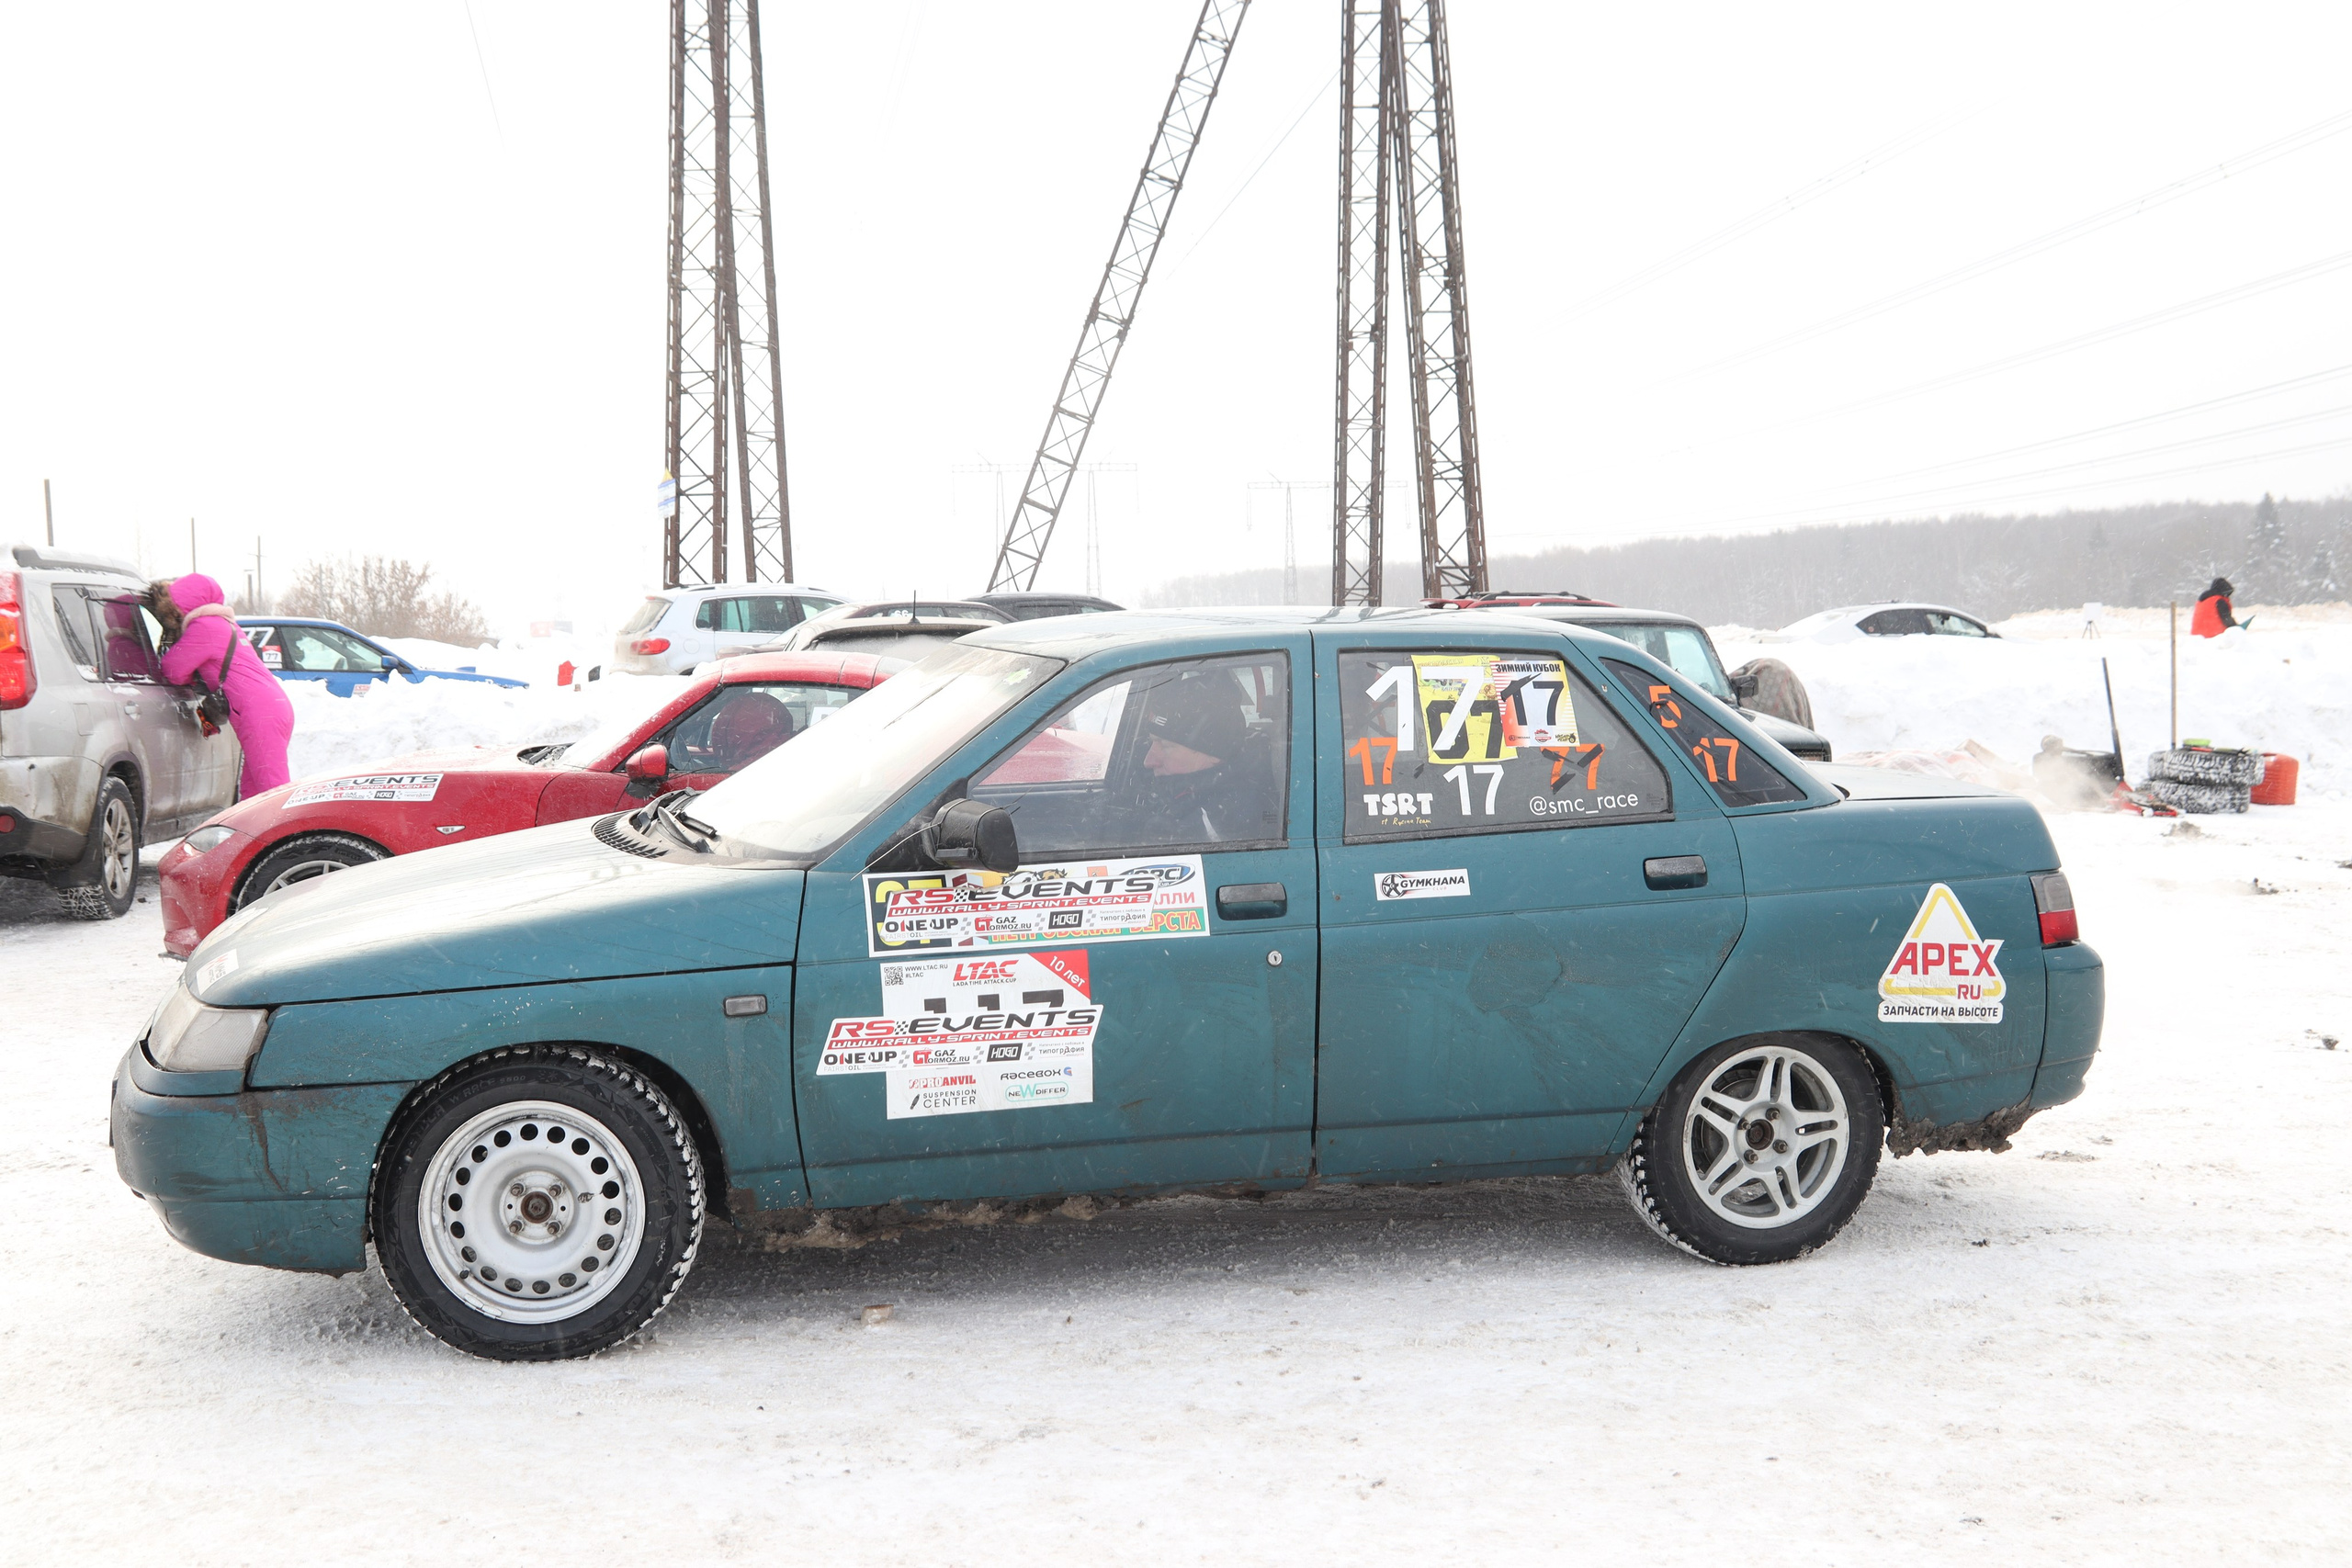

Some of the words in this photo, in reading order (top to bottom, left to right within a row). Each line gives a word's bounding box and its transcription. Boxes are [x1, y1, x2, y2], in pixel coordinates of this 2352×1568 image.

[1496, 662, 1532, 672] ЗИМНИЙ
[1533, 663, 1561, 672] КУБОК
[1365, 665, 1485, 751] 17
[1500, 680, 1565, 726] 17
[1349, 737, 1398, 786] 17
[1692, 738, 1739, 783] 17
[335, 774, 439, 787] EVENTS
[1443, 764, 1505, 816] 17
[1363, 793, 1433, 816] TSRT
[1529, 794, 1639, 816] @smc_race
[891, 888, 956, 906] RS
[967, 876, 1156, 901] EVENTS
[1400, 875, 1465, 888] GYMKHANA
[1154, 892, 1195, 906] ЛЛИ
[905, 964, 948, 972] WWW.LTAC.RU
[1890, 942, 1996, 976] APEX
[953, 960, 1019, 981] LTAC
[1049, 955, 1065, 972] 10
[1063, 968, 1086, 987] лет
[1957, 984, 1981, 999] RU
[1883, 1005, 1939, 1016] ЗАПЧАСТИ
[1941, 1007, 1955, 1017] НА
[1958, 1008, 1998, 1017] ВЫСОТЕ
[831, 1020, 895, 1038] RS
[909, 1010, 1097, 1033] EVENTS
[920, 1075, 976, 1089] PROANVIL
[922, 1089, 977, 1099] SUSPENSION
[923, 1096, 976, 1109] CENTER
